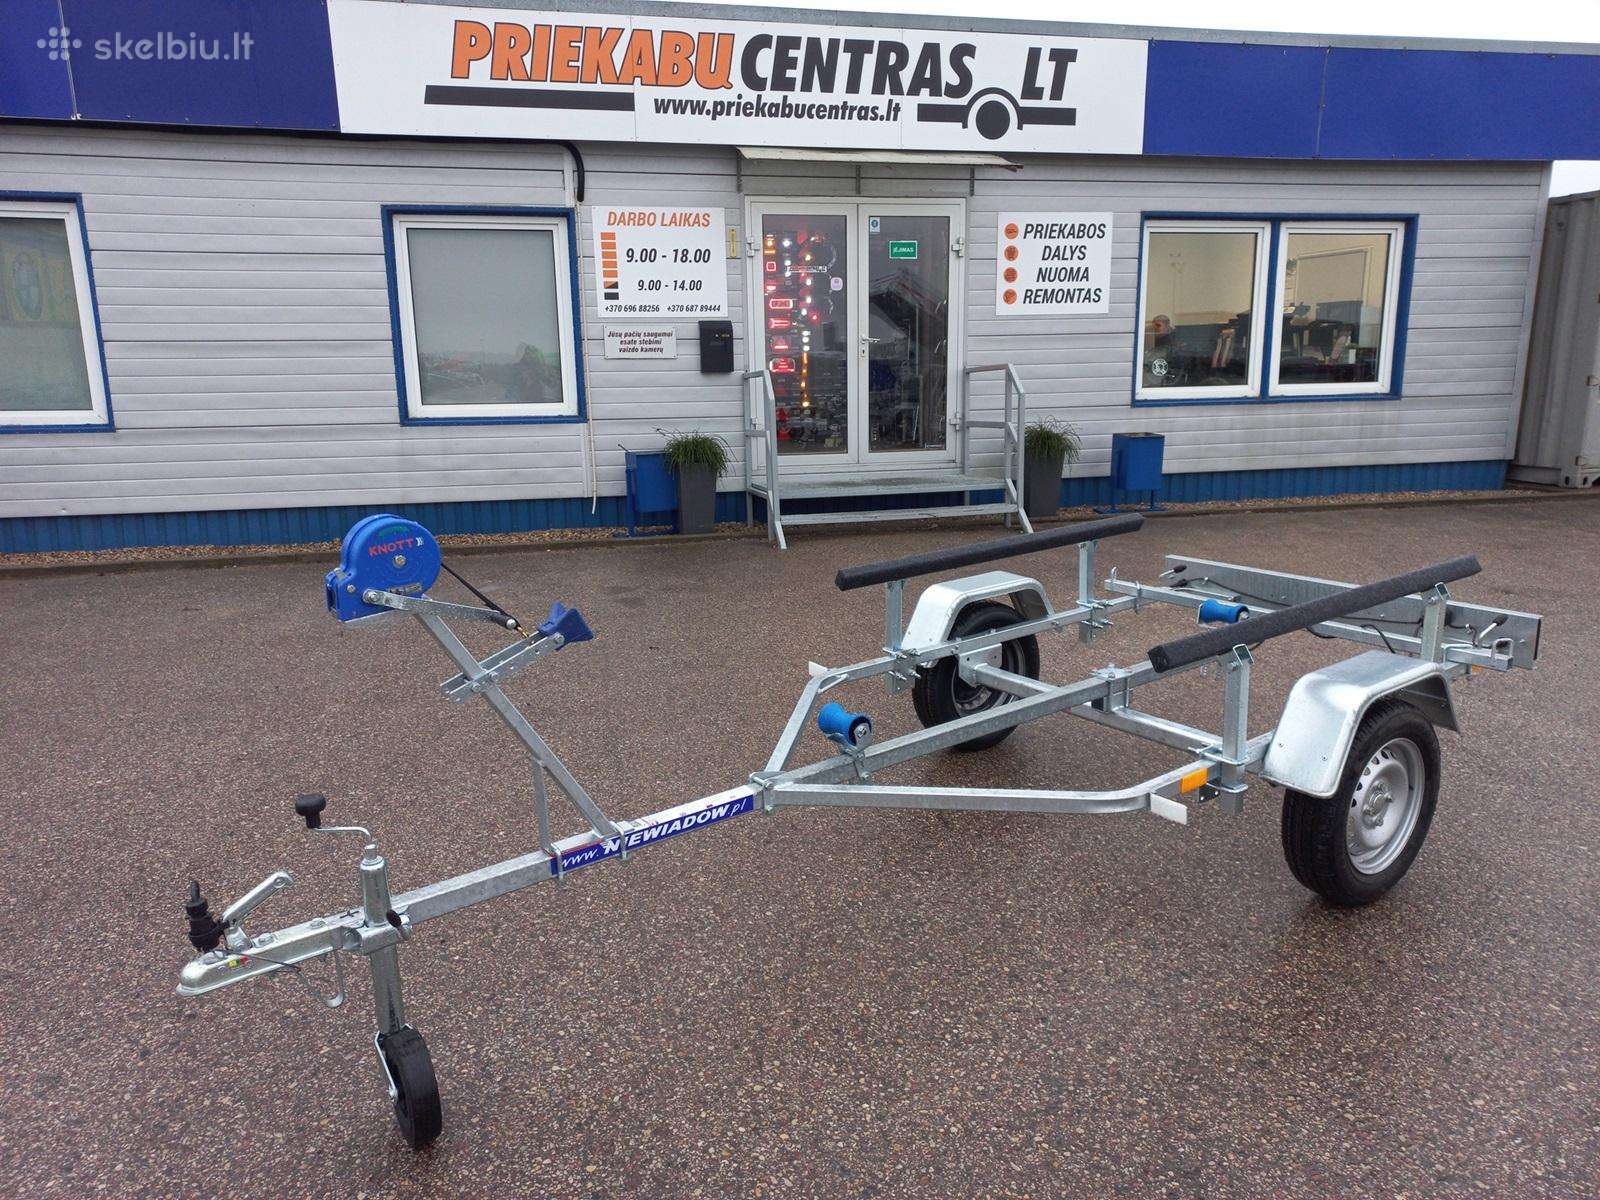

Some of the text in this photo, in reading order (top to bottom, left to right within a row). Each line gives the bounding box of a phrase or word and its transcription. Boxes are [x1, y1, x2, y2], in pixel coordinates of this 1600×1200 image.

[740, 33, 978, 99] CENTRAS
[654, 94, 902, 122] www.priekabucentras.lt
[607, 211, 711, 228] DARBO LAIKAS
[1023, 223, 1107, 239] PRIEKABOS
[626, 248, 657, 263] 9.00
[672, 248, 711, 264] 18.00
[1041, 245, 1088, 261] DALYS
[1036, 267, 1090, 282] NUOMA
[637, 280, 662, 291] 9.00
[673, 280, 702, 291] 14.00
[1023, 288, 1102, 304] REMONTAS
[605, 304, 721, 313] +370 696 88256 +370 687 89444
[368, 537, 414, 557] KNOTT
